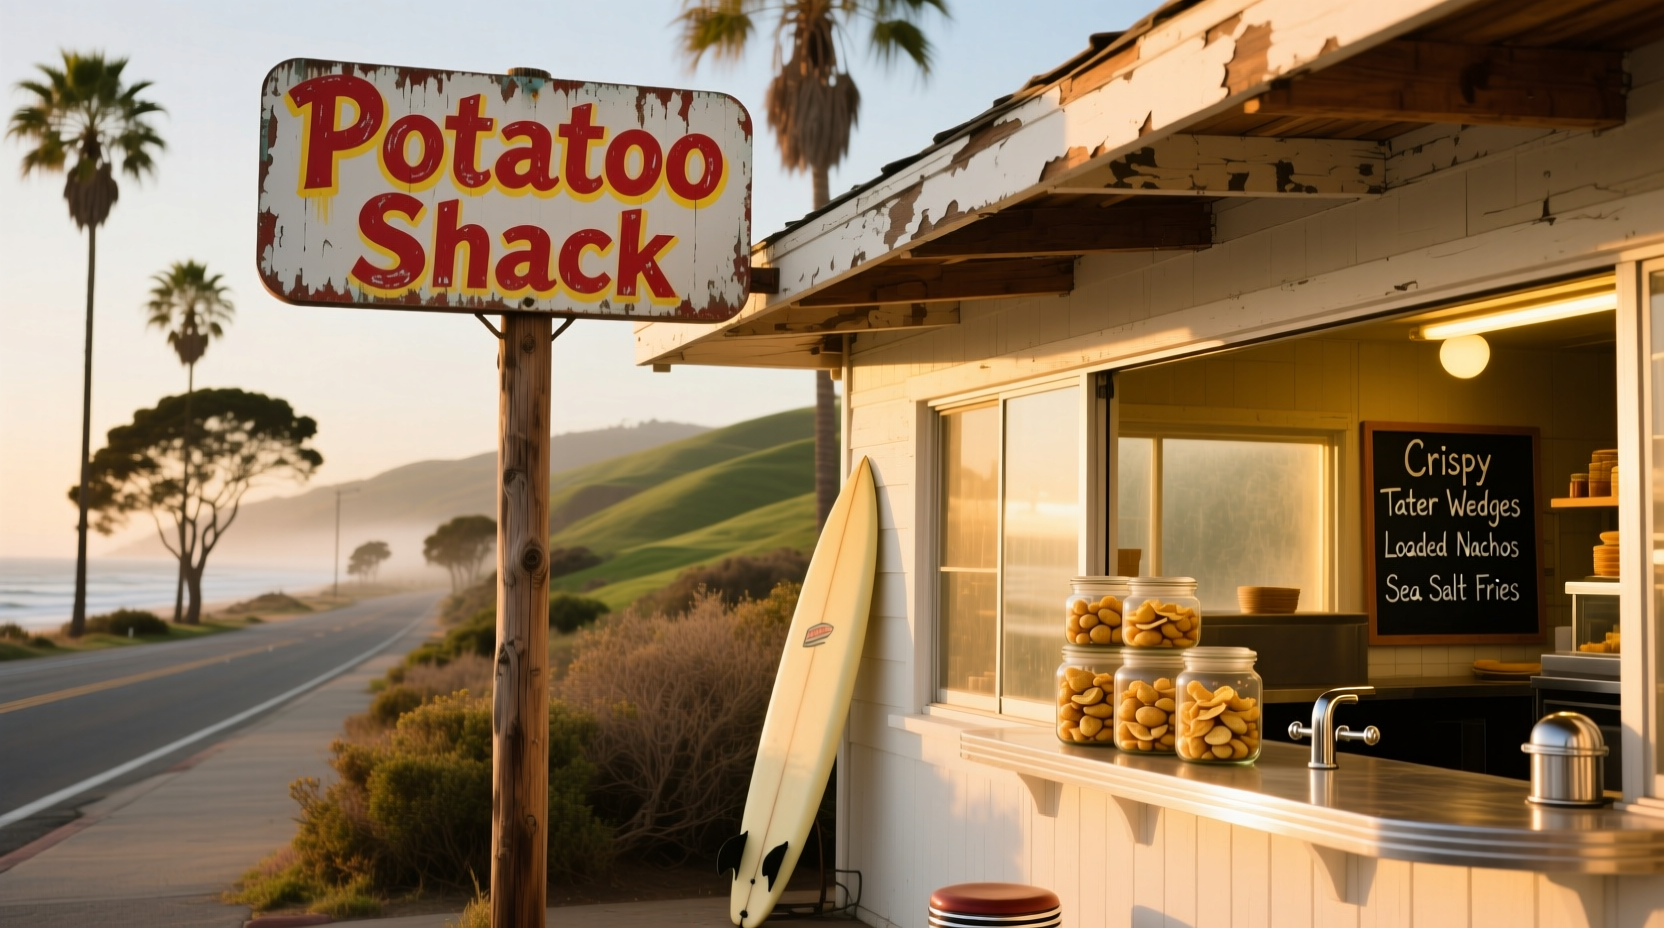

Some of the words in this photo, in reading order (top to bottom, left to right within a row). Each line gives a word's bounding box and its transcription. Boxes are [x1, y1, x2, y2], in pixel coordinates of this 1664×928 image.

[286, 74, 727, 204] Potatoo
[350, 191, 679, 303] Shack
[1404, 438, 1492, 487] Crispy
[1379, 487, 1439, 517] Tater
[1446, 488, 1521, 528] Wedges
[1384, 530, 1448, 559] Loaded
[1456, 530, 1520, 558] Nachos
[1385, 573, 1423, 603] Sea
[1428, 573, 1467, 602] Salt
[1475, 573, 1520, 602] Fries
